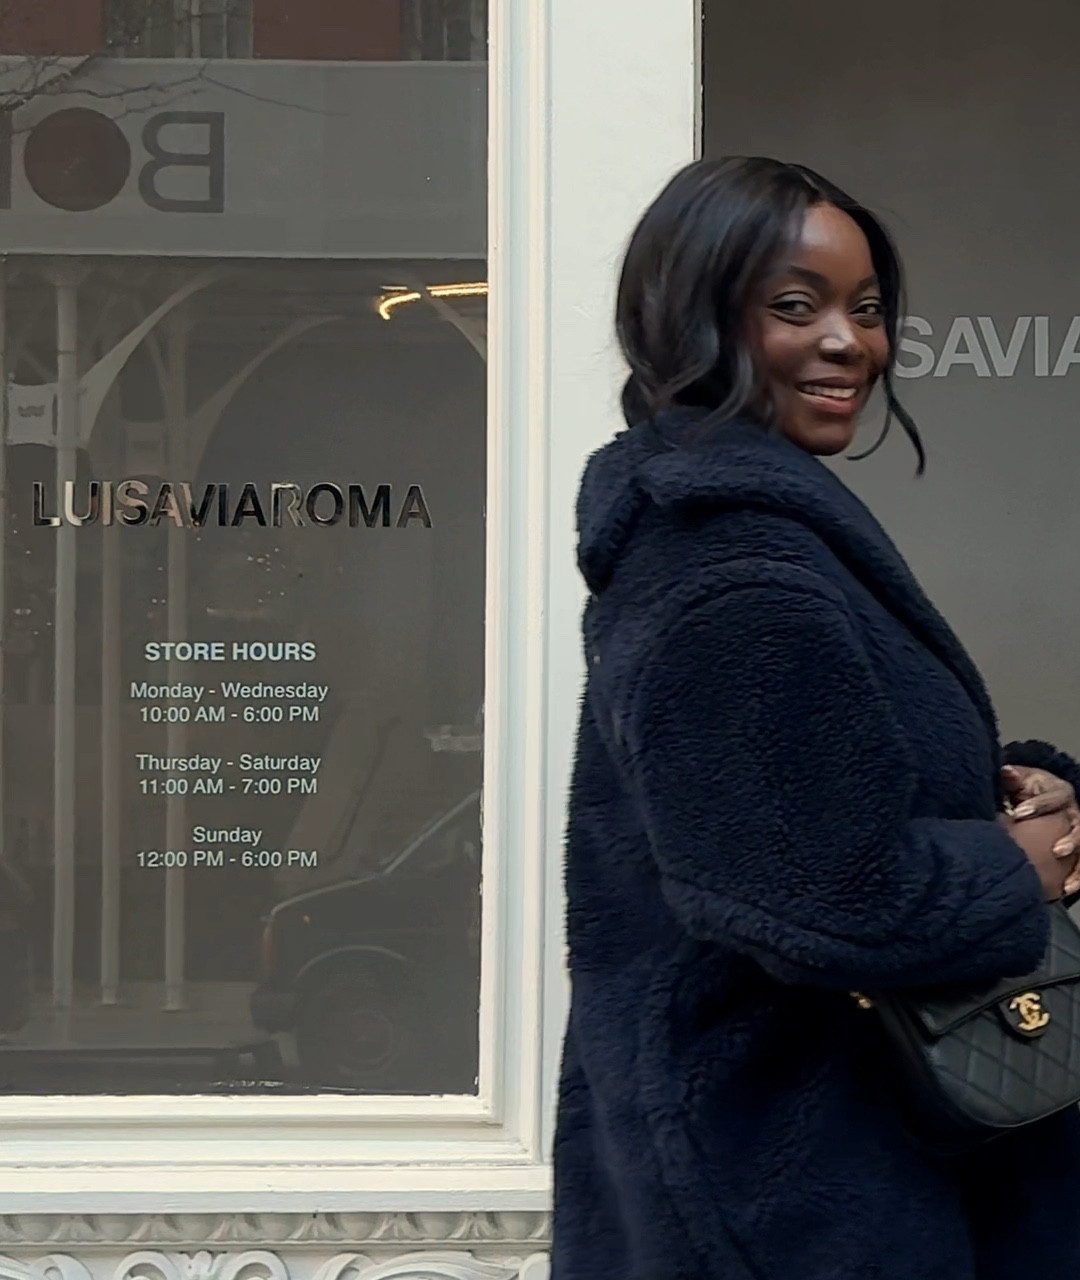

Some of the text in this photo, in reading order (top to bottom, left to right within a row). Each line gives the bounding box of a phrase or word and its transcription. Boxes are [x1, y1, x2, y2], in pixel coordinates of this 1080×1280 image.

[32, 480, 433, 529] LUISAVIAROMA
[144, 642, 317, 661] STORE HOURS
[130, 682, 205, 703] Monday
[220, 681, 329, 702] Wednesday
[140, 706, 191, 723] 10:00
[194, 706, 226, 722] AM
[243, 706, 283, 723] 6:00
[289, 705, 319, 722] PM
[135, 753, 222, 775] Thursday
[239, 753, 322, 775] Saturday
[139, 778, 189, 795] 11:00
[192, 778, 223, 794] AM
[241, 778, 282, 795] 7:00
[287, 777, 318, 794] PM
[192, 826, 263, 847] Sunday
[137, 850, 188, 868] 12:00
[193, 850, 224, 868] PM
[241, 850, 283, 868] 6:00
[287, 850, 318, 868] PM
